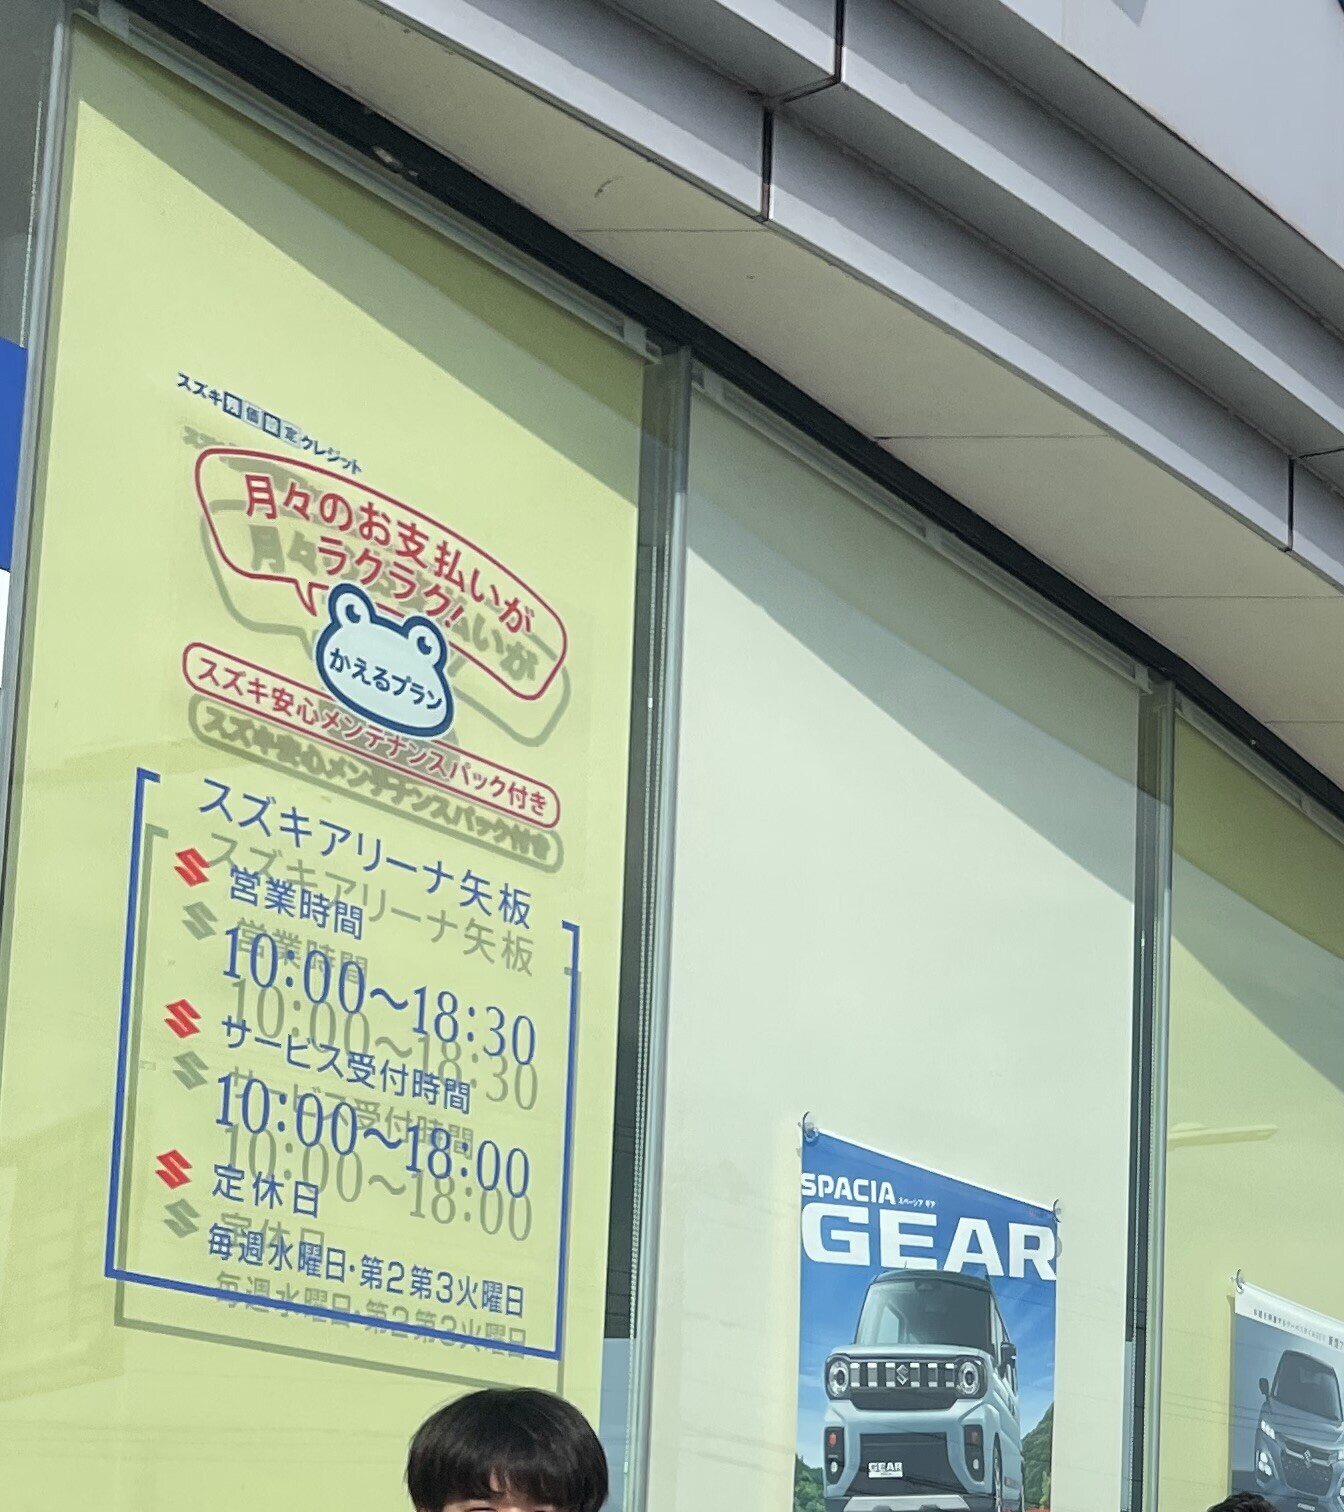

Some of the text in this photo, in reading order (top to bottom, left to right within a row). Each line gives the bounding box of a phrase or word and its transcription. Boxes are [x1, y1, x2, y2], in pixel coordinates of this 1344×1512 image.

[244, 473, 535, 634] 月々のお支払いが
[329, 646, 443, 711] かえるプラン
[197, 657, 548, 816] スズキ安心メンテナンスパック付き
[198, 777, 533, 930] スズキアリーナ矢板
[228, 864, 364, 940] 営業時間
[220, 1015, 471, 1114] サービス受付時間
[211, 1163, 320, 1218] 定休日
[801, 1172, 897, 1205] SPACIA
[801, 1202, 1057, 1281] GEAR
